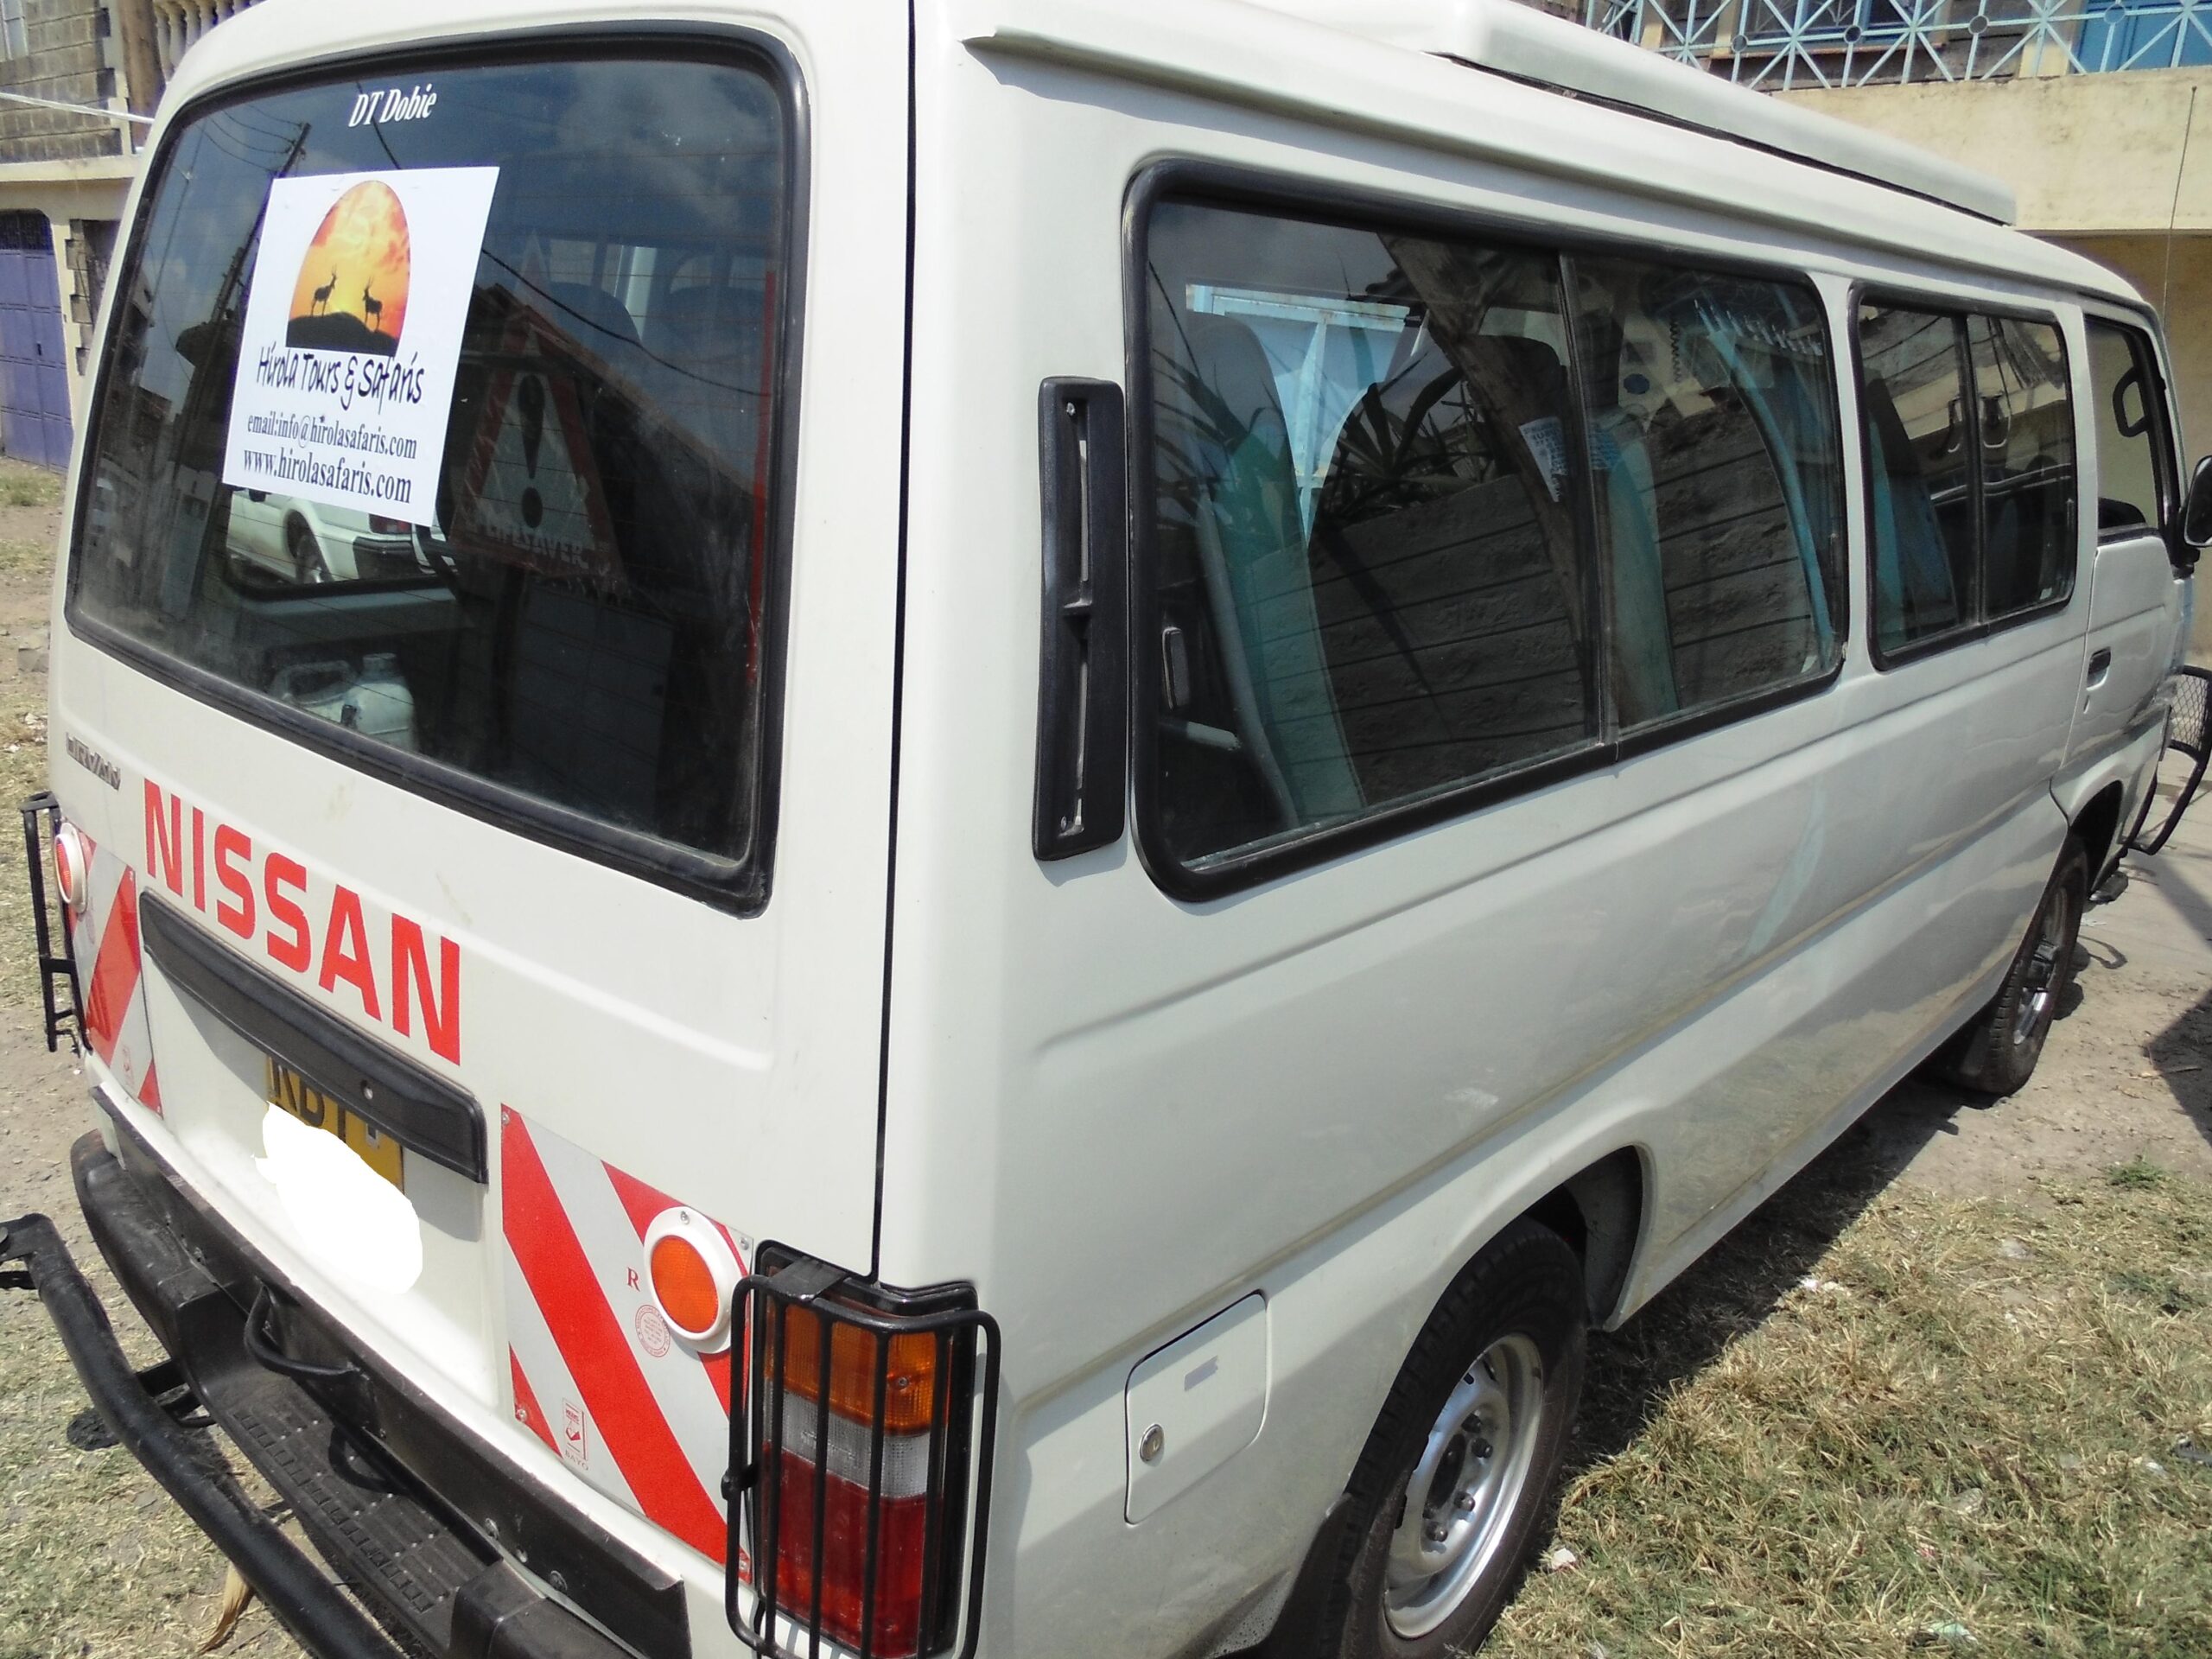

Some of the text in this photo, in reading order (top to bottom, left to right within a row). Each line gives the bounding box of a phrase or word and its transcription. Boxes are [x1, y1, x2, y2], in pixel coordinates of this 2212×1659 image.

[348, 83, 437, 127] DT Dobie
[257, 341, 424, 415] Hirola Tours & Safaris
[244, 447, 411, 504] www.hirolasafaris.com
[144, 778, 461, 1066] NISSAN
[627, 1266, 641, 1293] R
